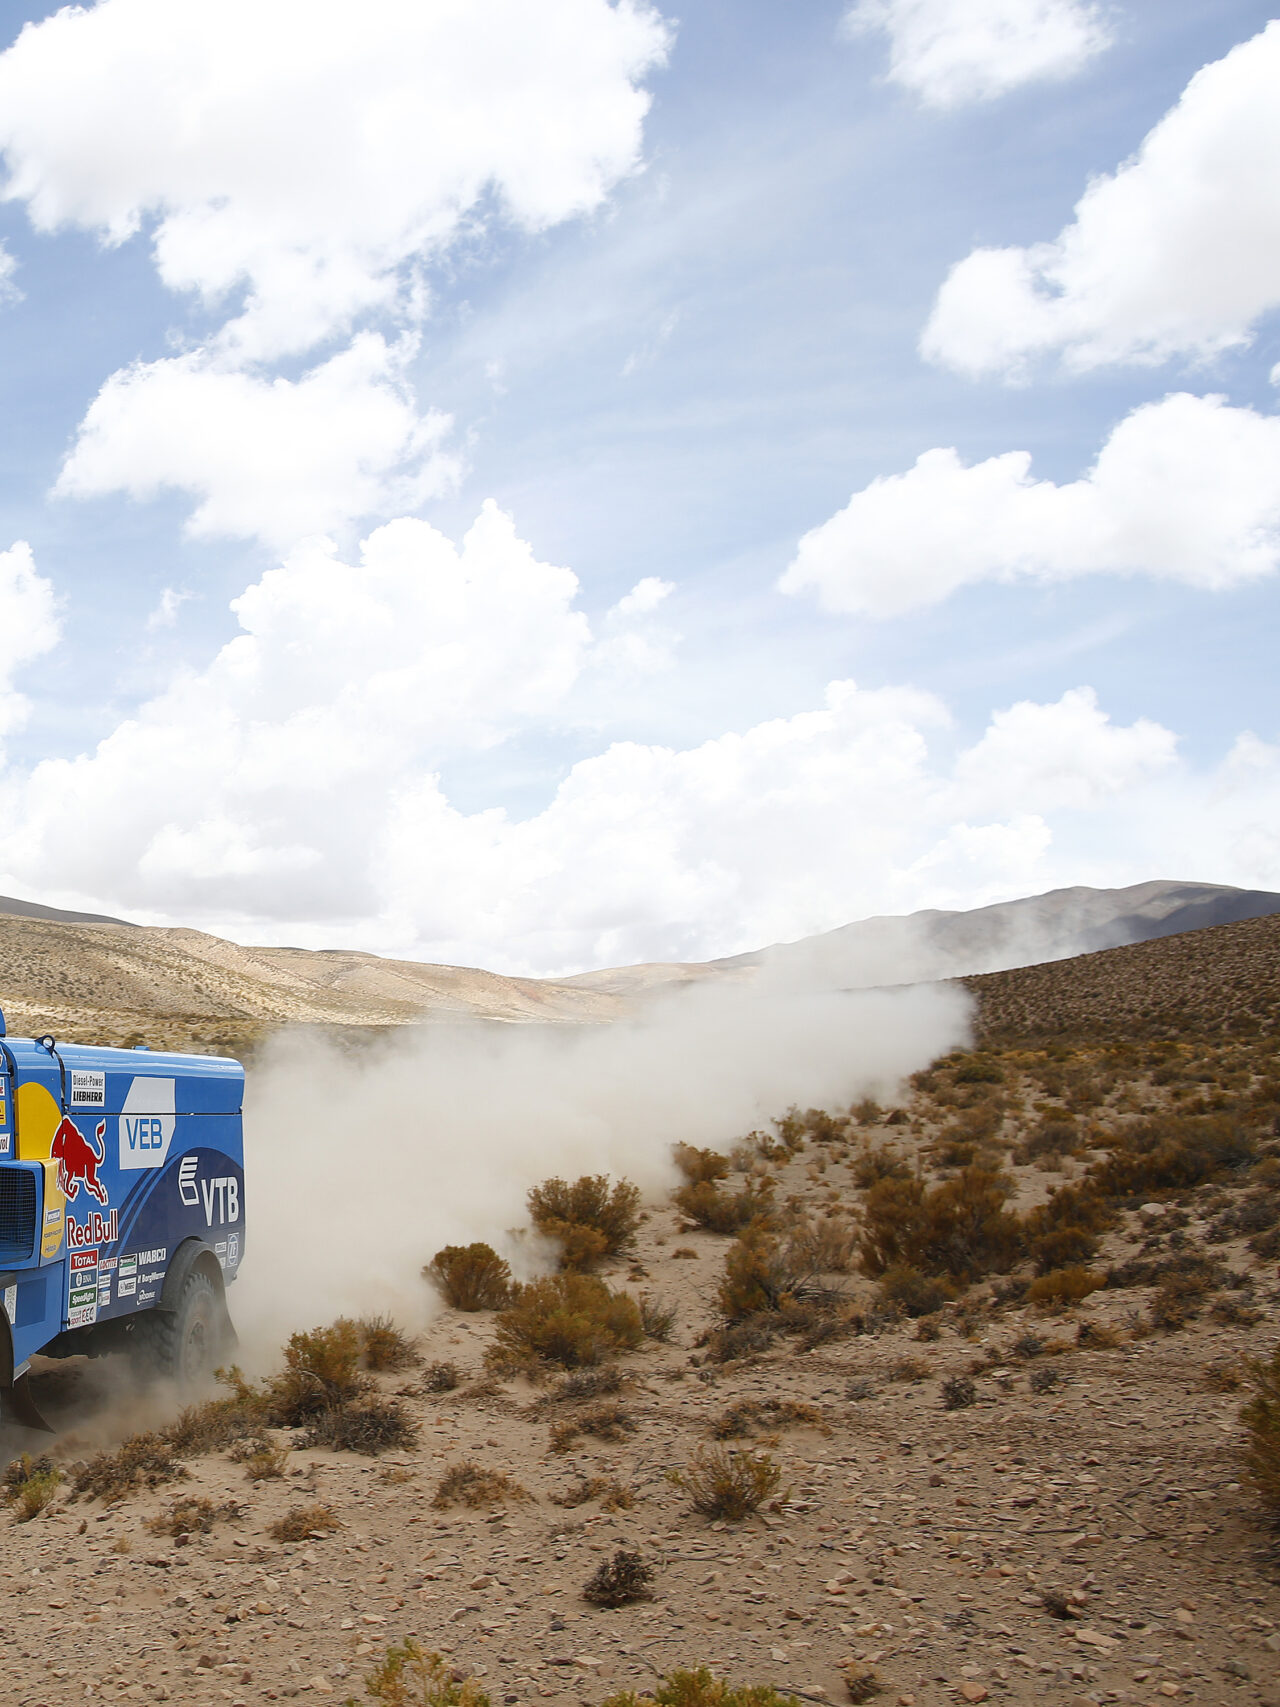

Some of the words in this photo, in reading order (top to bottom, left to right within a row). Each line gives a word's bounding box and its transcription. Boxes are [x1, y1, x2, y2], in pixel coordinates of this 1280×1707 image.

[73, 1074, 103, 1087] Diesel-Power
[73, 1091, 103, 1102] LIEBHERR
[125, 1118, 163, 1150] VEB
[201, 1176, 239, 1227] VTB
[66, 1211, 93, 1249] Red
[93, 1208, 118, 1245] Bull
[74, 1255, 96, 1267] TOTAL
[138, 1248, 167, 1265] WABCO
